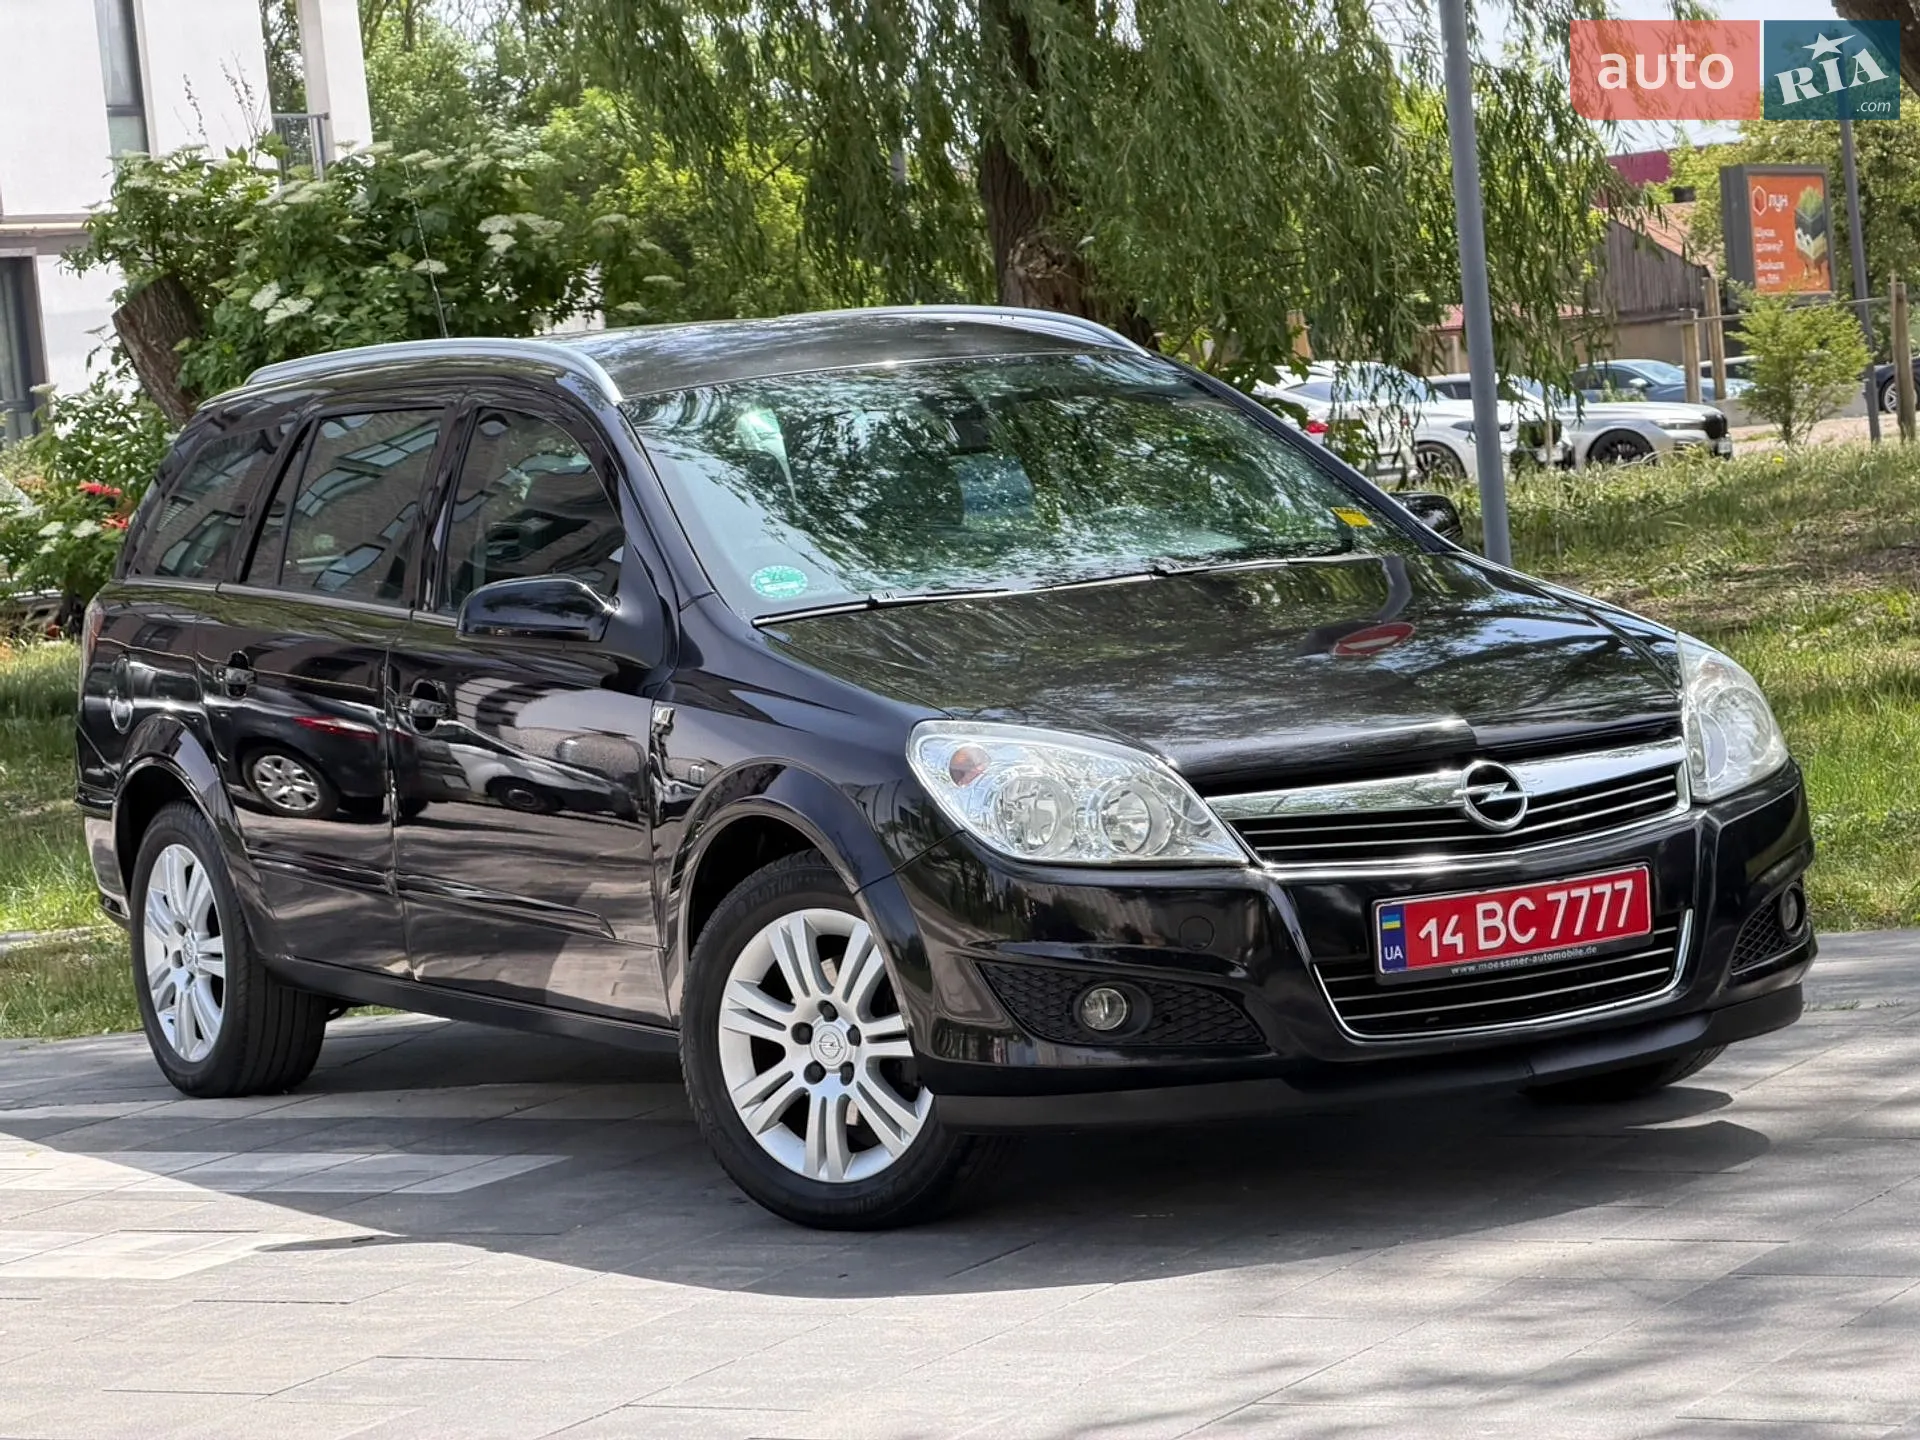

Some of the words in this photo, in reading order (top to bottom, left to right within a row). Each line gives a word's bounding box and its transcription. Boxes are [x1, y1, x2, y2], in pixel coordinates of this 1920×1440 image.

[1417, 914, 1464, 958] 14
[1476, 897, 1536, 950] BC
[1547, 880, 1633, 940] 7777
[1385, 946, 1403, 961] UA
